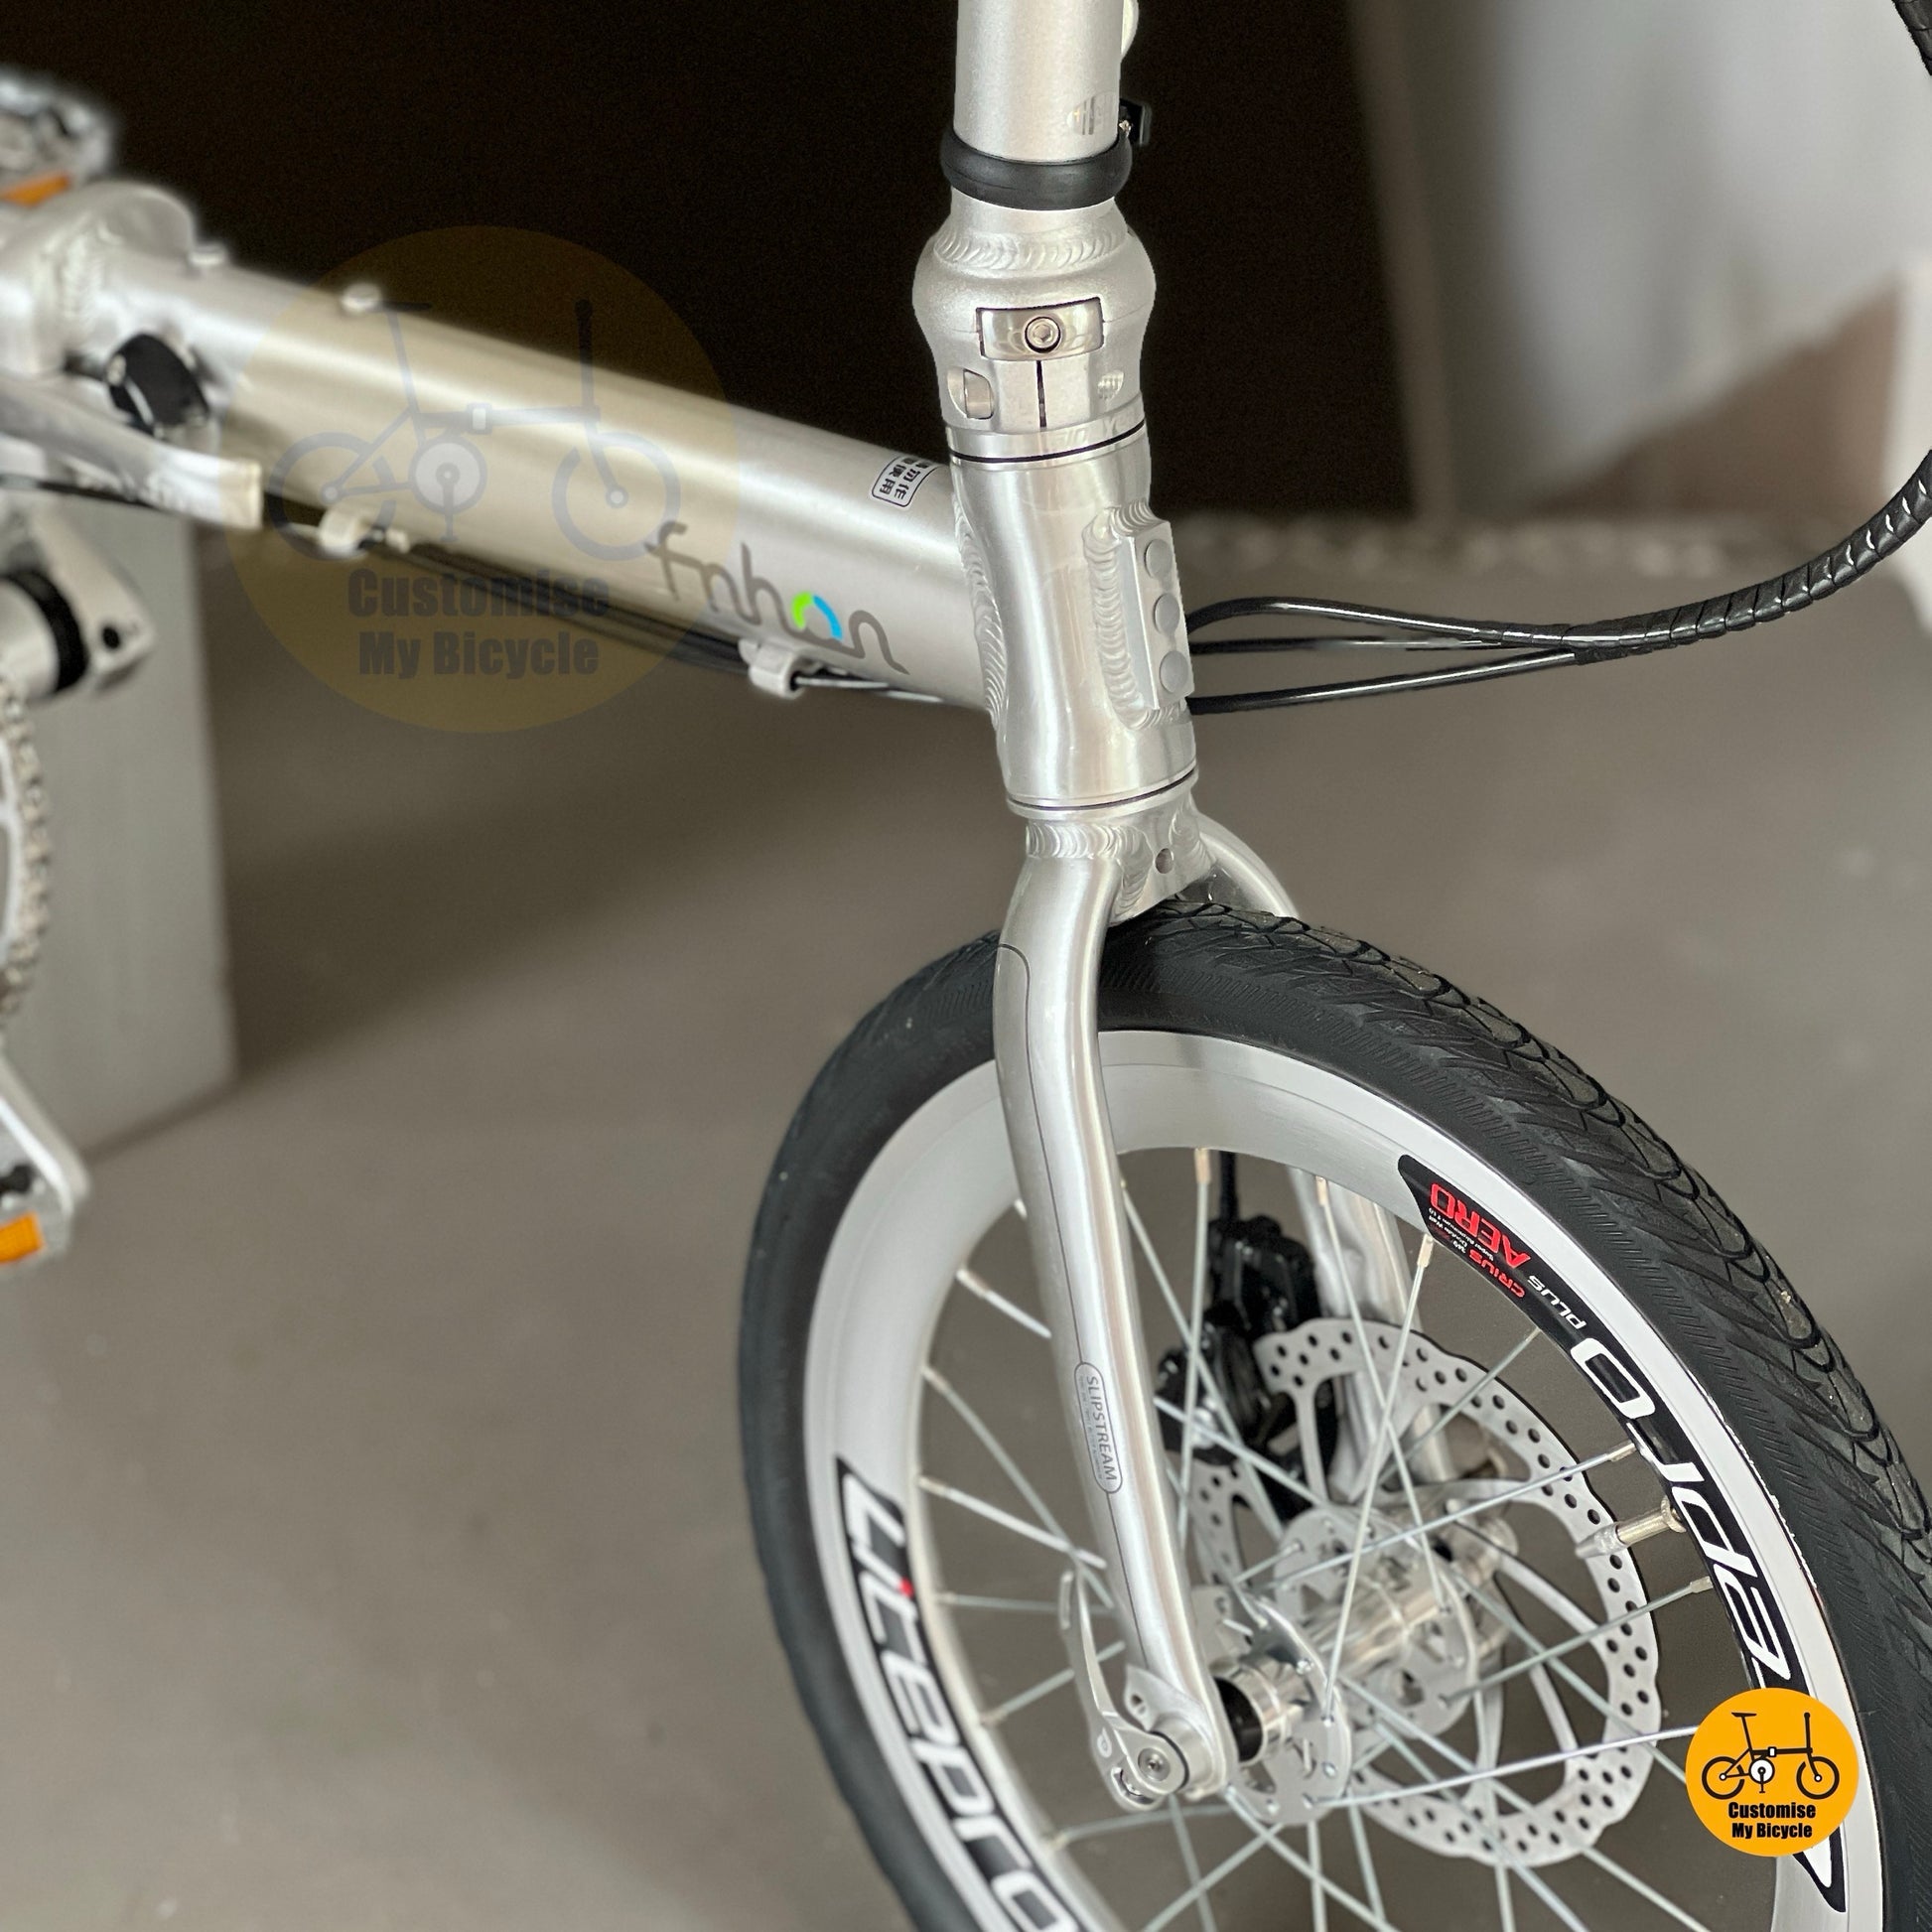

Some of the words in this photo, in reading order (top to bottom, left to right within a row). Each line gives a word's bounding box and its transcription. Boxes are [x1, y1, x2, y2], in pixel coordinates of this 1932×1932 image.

[643, 521, 910, 675] fnhon
[1430, 1182, 1532, 1270] AERO
[1468, 1248, 1526, 1299] CRIUS
[1527, 1275, 1587, 1330] PLUS
[1086, 1376, 1118, 1481] SLIPSTREAM
